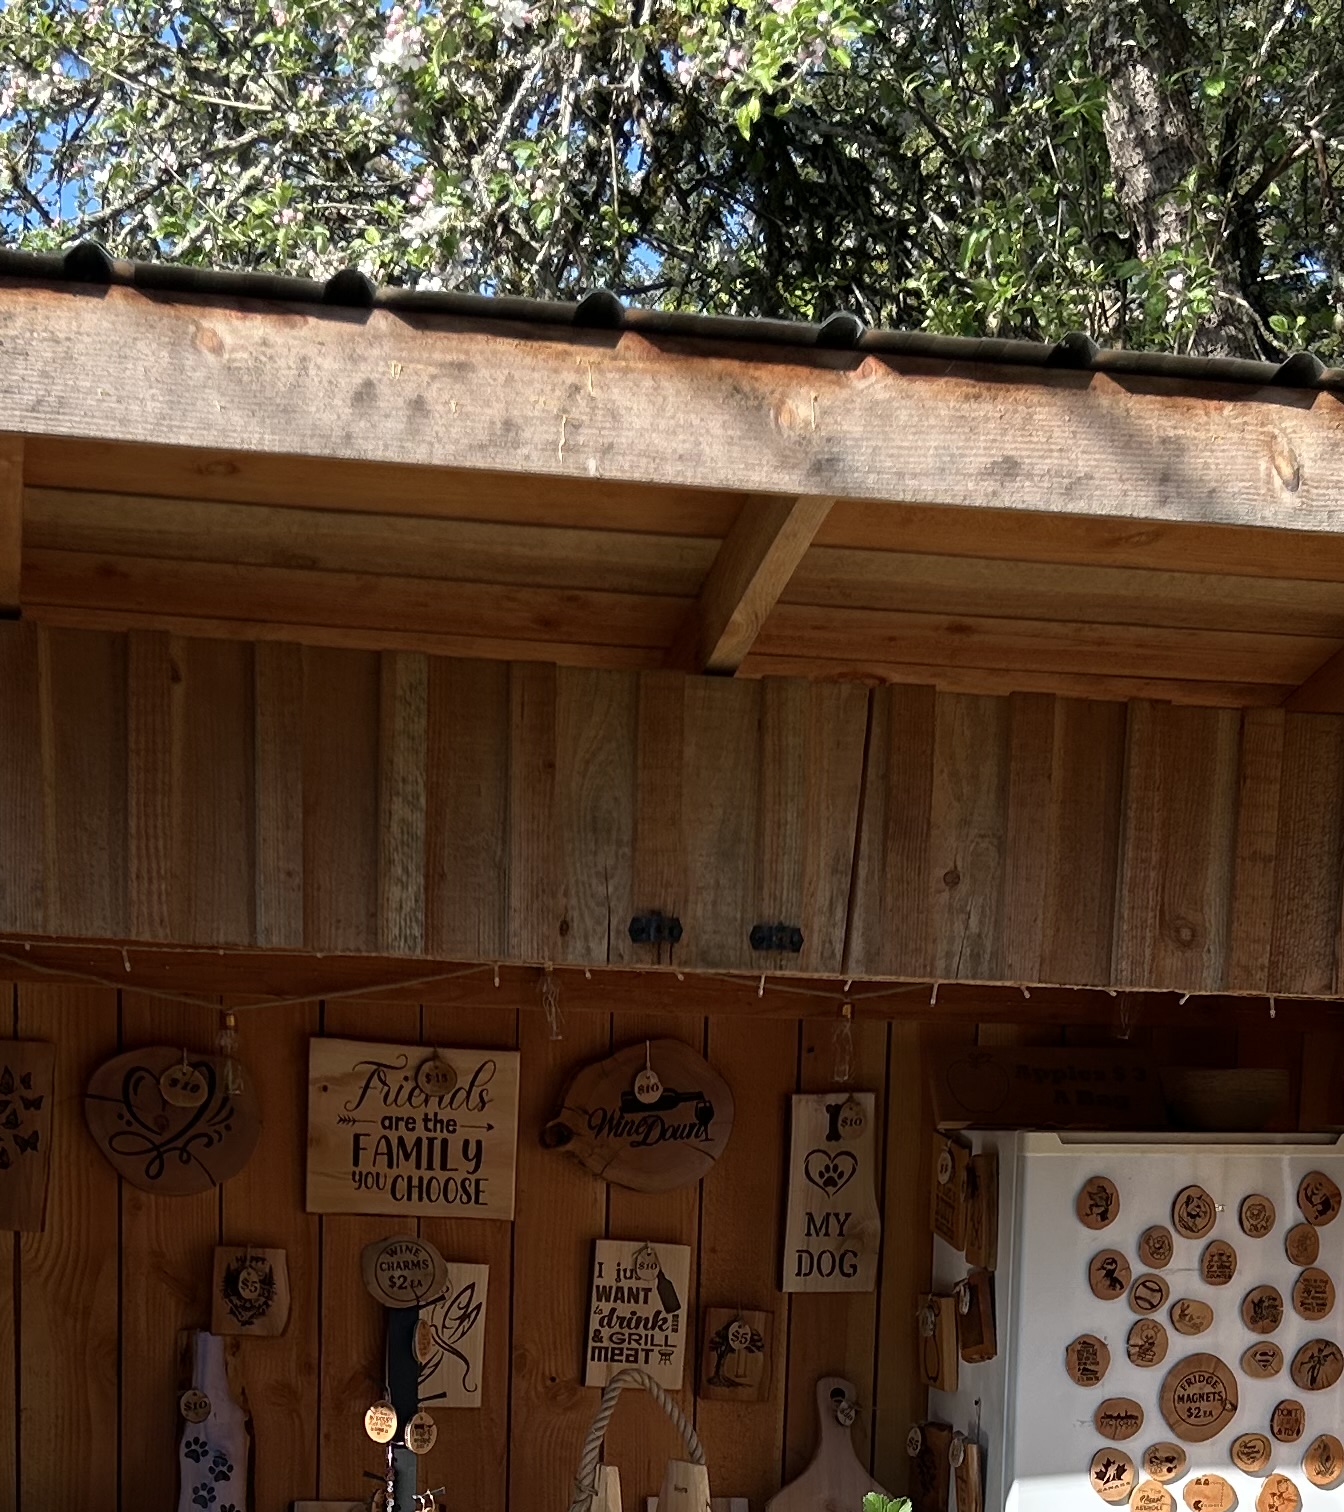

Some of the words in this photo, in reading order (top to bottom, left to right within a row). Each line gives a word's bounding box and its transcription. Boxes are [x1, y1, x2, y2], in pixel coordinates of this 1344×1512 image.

[343, 1053, 497, 1112] Friends
[1015, 1065, 1105, 1084] Apples
[168, 1078, 201, 1094] $10
[637, 1083, 660, 1095] $10
[1054, 1089, 1071, 1105] A
[380, 1115, 417, 1132] are
[422, 1111, 458, 1134] the
[840, 1116, 863, 1129] $10
[352, 1133, 484, 1175] FAMILY
[390, 1174, 490, 1206] CHOOSE
[804, 1212, 852, 1238] MY
[386, 1244, 423, 1260] WINE
[379, 1259, 430, 1273] CHARMS
[596, 1261, 604, 1279] I
[638, 1262, 658, 1271] $10
[794, 1249, 859, 1278] DOG
[241, 1278, 258, 1293] $5
[388, 1274, 408, 1290] $2
[409, 1279, 423, 1290] EA
[595, 1284, 653, 1305] WANT
[593, 1304, 603, 1315] to
[598, 1306, 670, 1333] drink
[591, 1328, 604, 1344] &
[608, 1331, 677, 1348] GRILL
[730, 1330, 750, 1345] $5
[1180, 1374, 1221, 1392] FRIDGE
[183, 1400, 208, 1411] $10
[1177, 1390, 1224, 1405] MAGNETS
[1186, 1406, 1202, 1419] $2
[1203, 1409, 1214, 1418] EA
